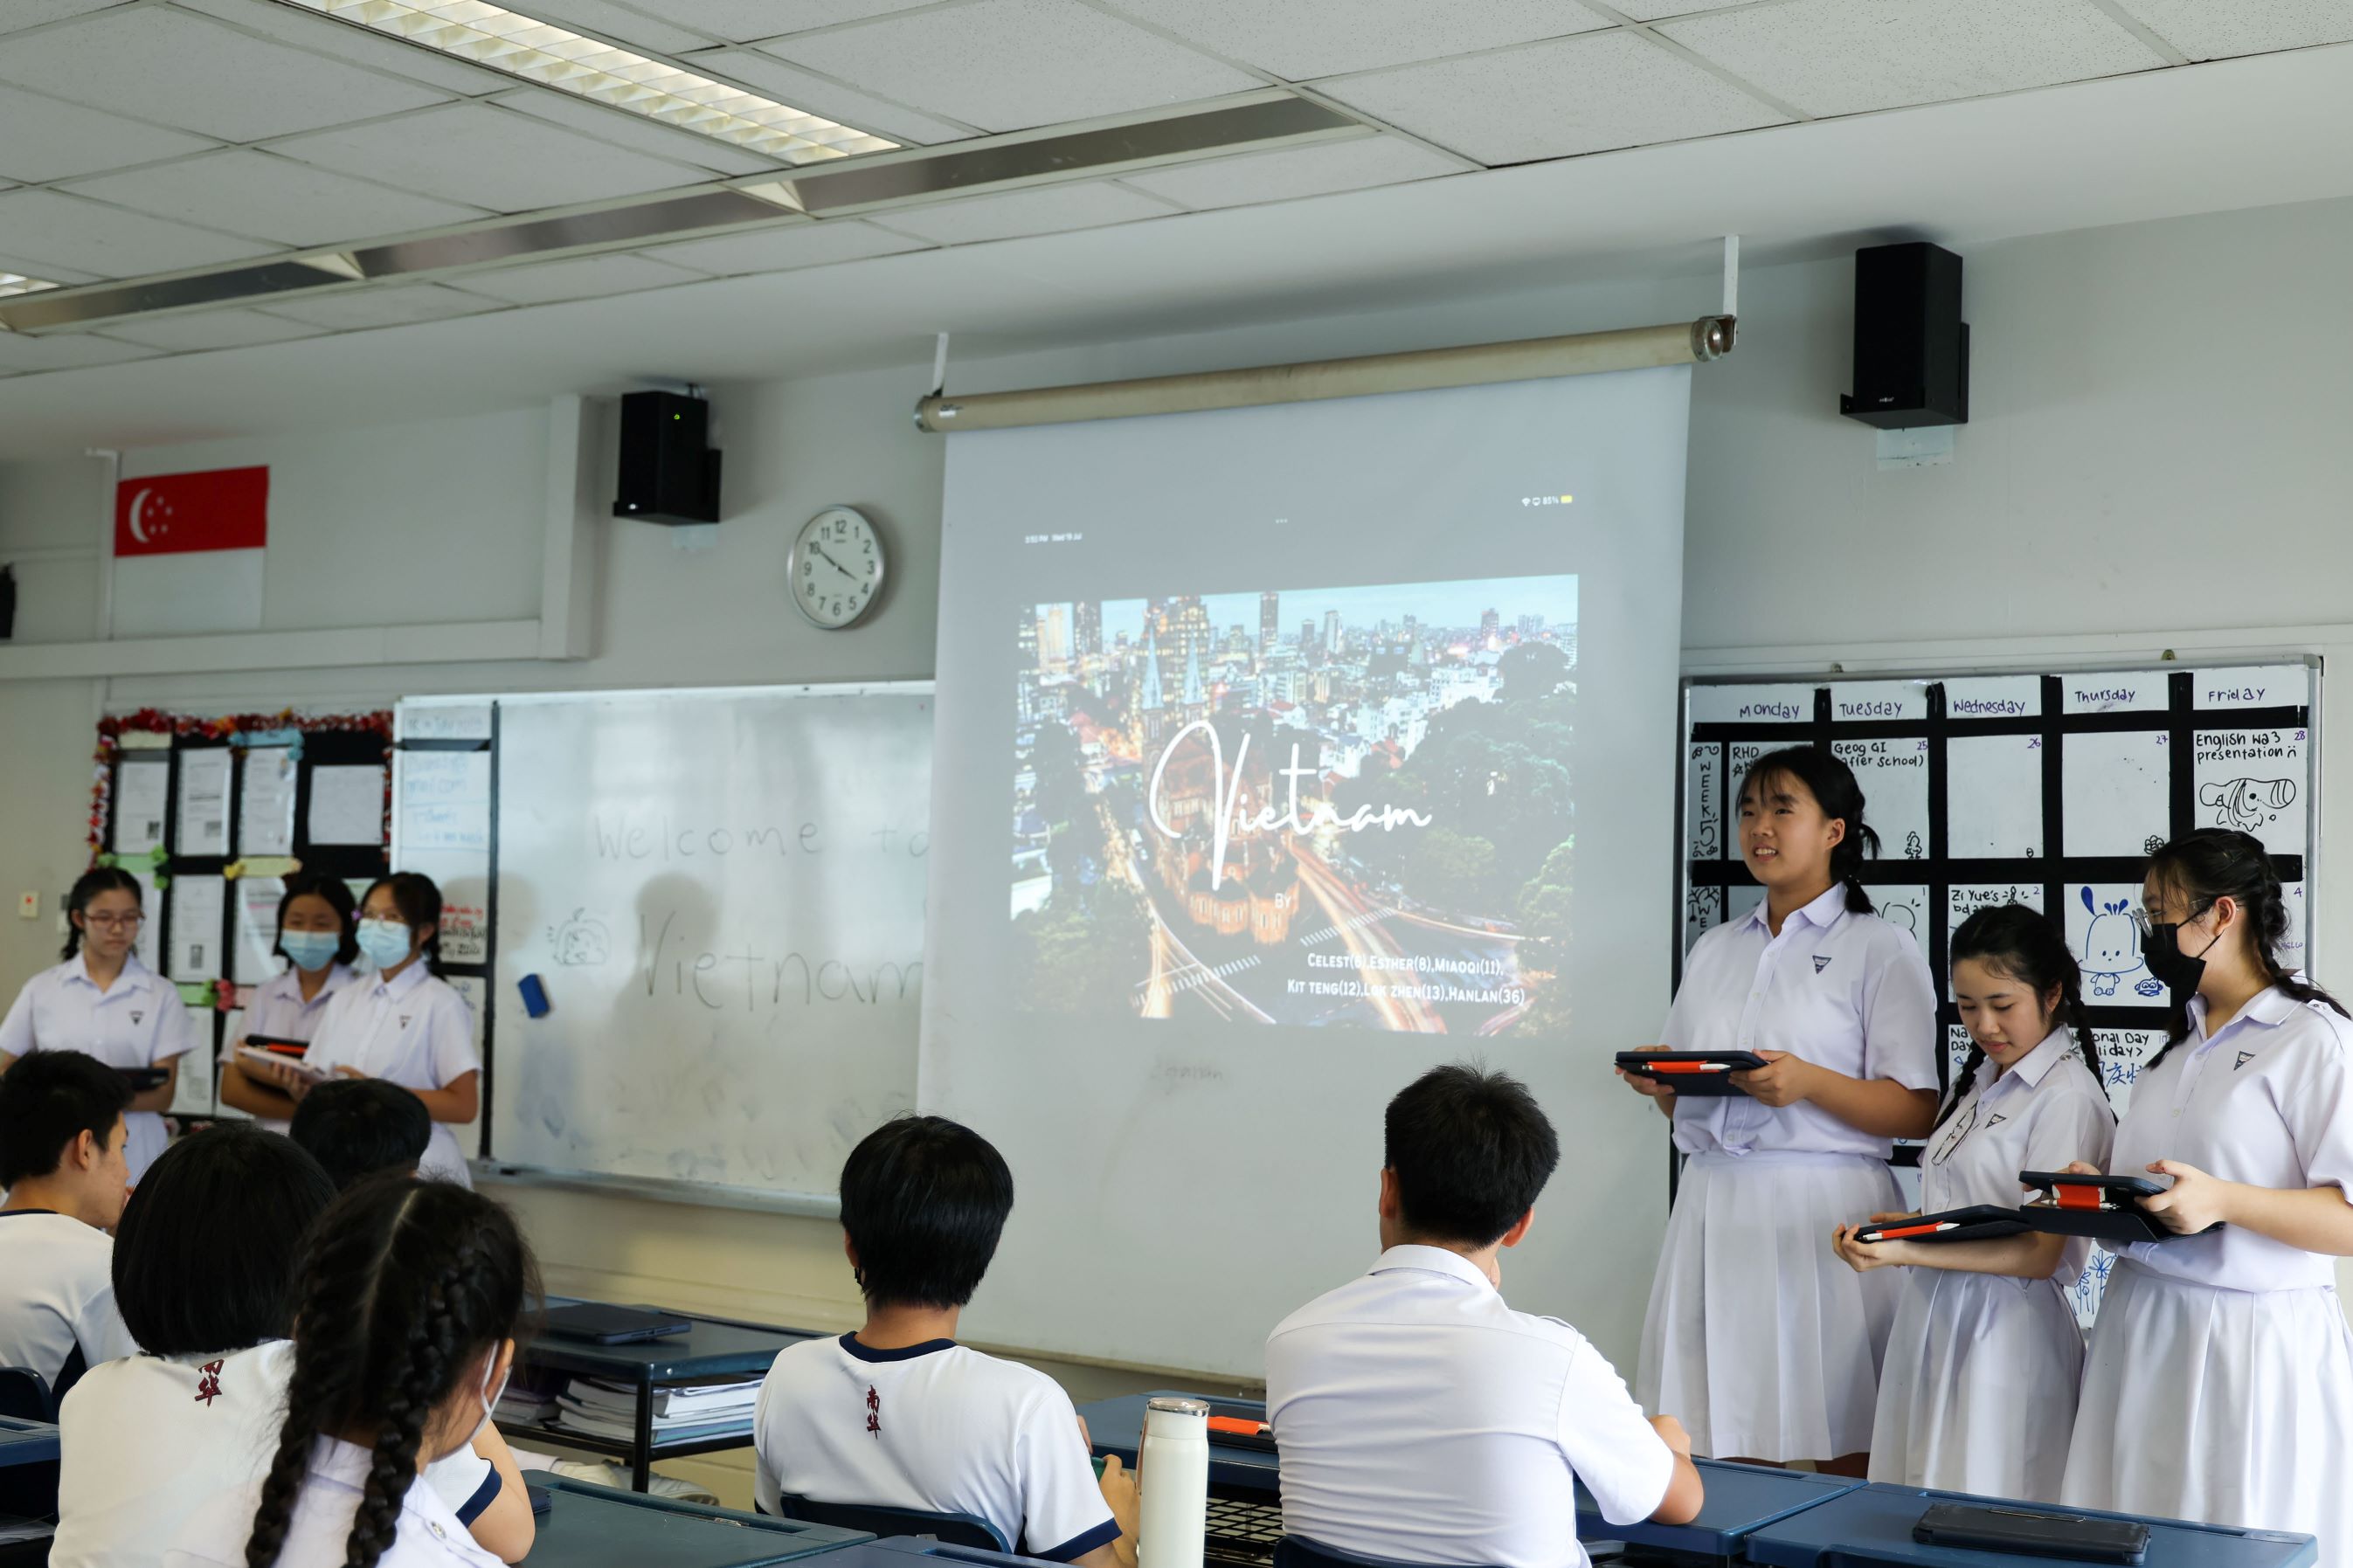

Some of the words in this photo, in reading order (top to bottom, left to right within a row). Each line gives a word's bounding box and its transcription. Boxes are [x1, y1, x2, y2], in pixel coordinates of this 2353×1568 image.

[821, 527, 830, 540] 11
[835, 520, 847, 534] 12
[855, 526, 860, 539] 1
[809, 541, 820, 555] 10
[863, 540, 872, 554] 2
[804, 562, 812, 576] 9
[867, 560, 875, 575] 3
[807, 583, 815, 597] 8
[862, 583, 869, 595] 4
[819, 596, 827, 610] 7
[833, 602, 841, 616] 6
[849, 596, 857, 611] 5
[1740, 701, 1800, 719] Monday
[1839, 701, 1902, 717] Tuesday
[1954, 699, 2025, 715] Wednesday
[2074, 687, 2136, 703] Thursday
[2209, 687, 2266, 701] Friday
[2027, 737, 2041, 749] 26
[2156, 735, 2169, 745] 27
[2196, 732, 2246, 751] English
[2294, 730, 2306, 742] 28
[1835, 743, 1866, 756] Geog
[1917, 741, 1928, 750] 25
[1733, 746, 1760, 760] RHD
[2197, 746, 2284, 765] presentation
[1149, 720, 1433, 892] Vietnam
[594, 814, 823, 861] Welcome
[1968, 889, 1999, 902] Yue's
[2033, 886, 2040, 895] 2
[2294, 887, 2302, 898] 4
[640, 910, 924, 1012] Vietnam
[2124, 1033, 2149, 1046] Day
